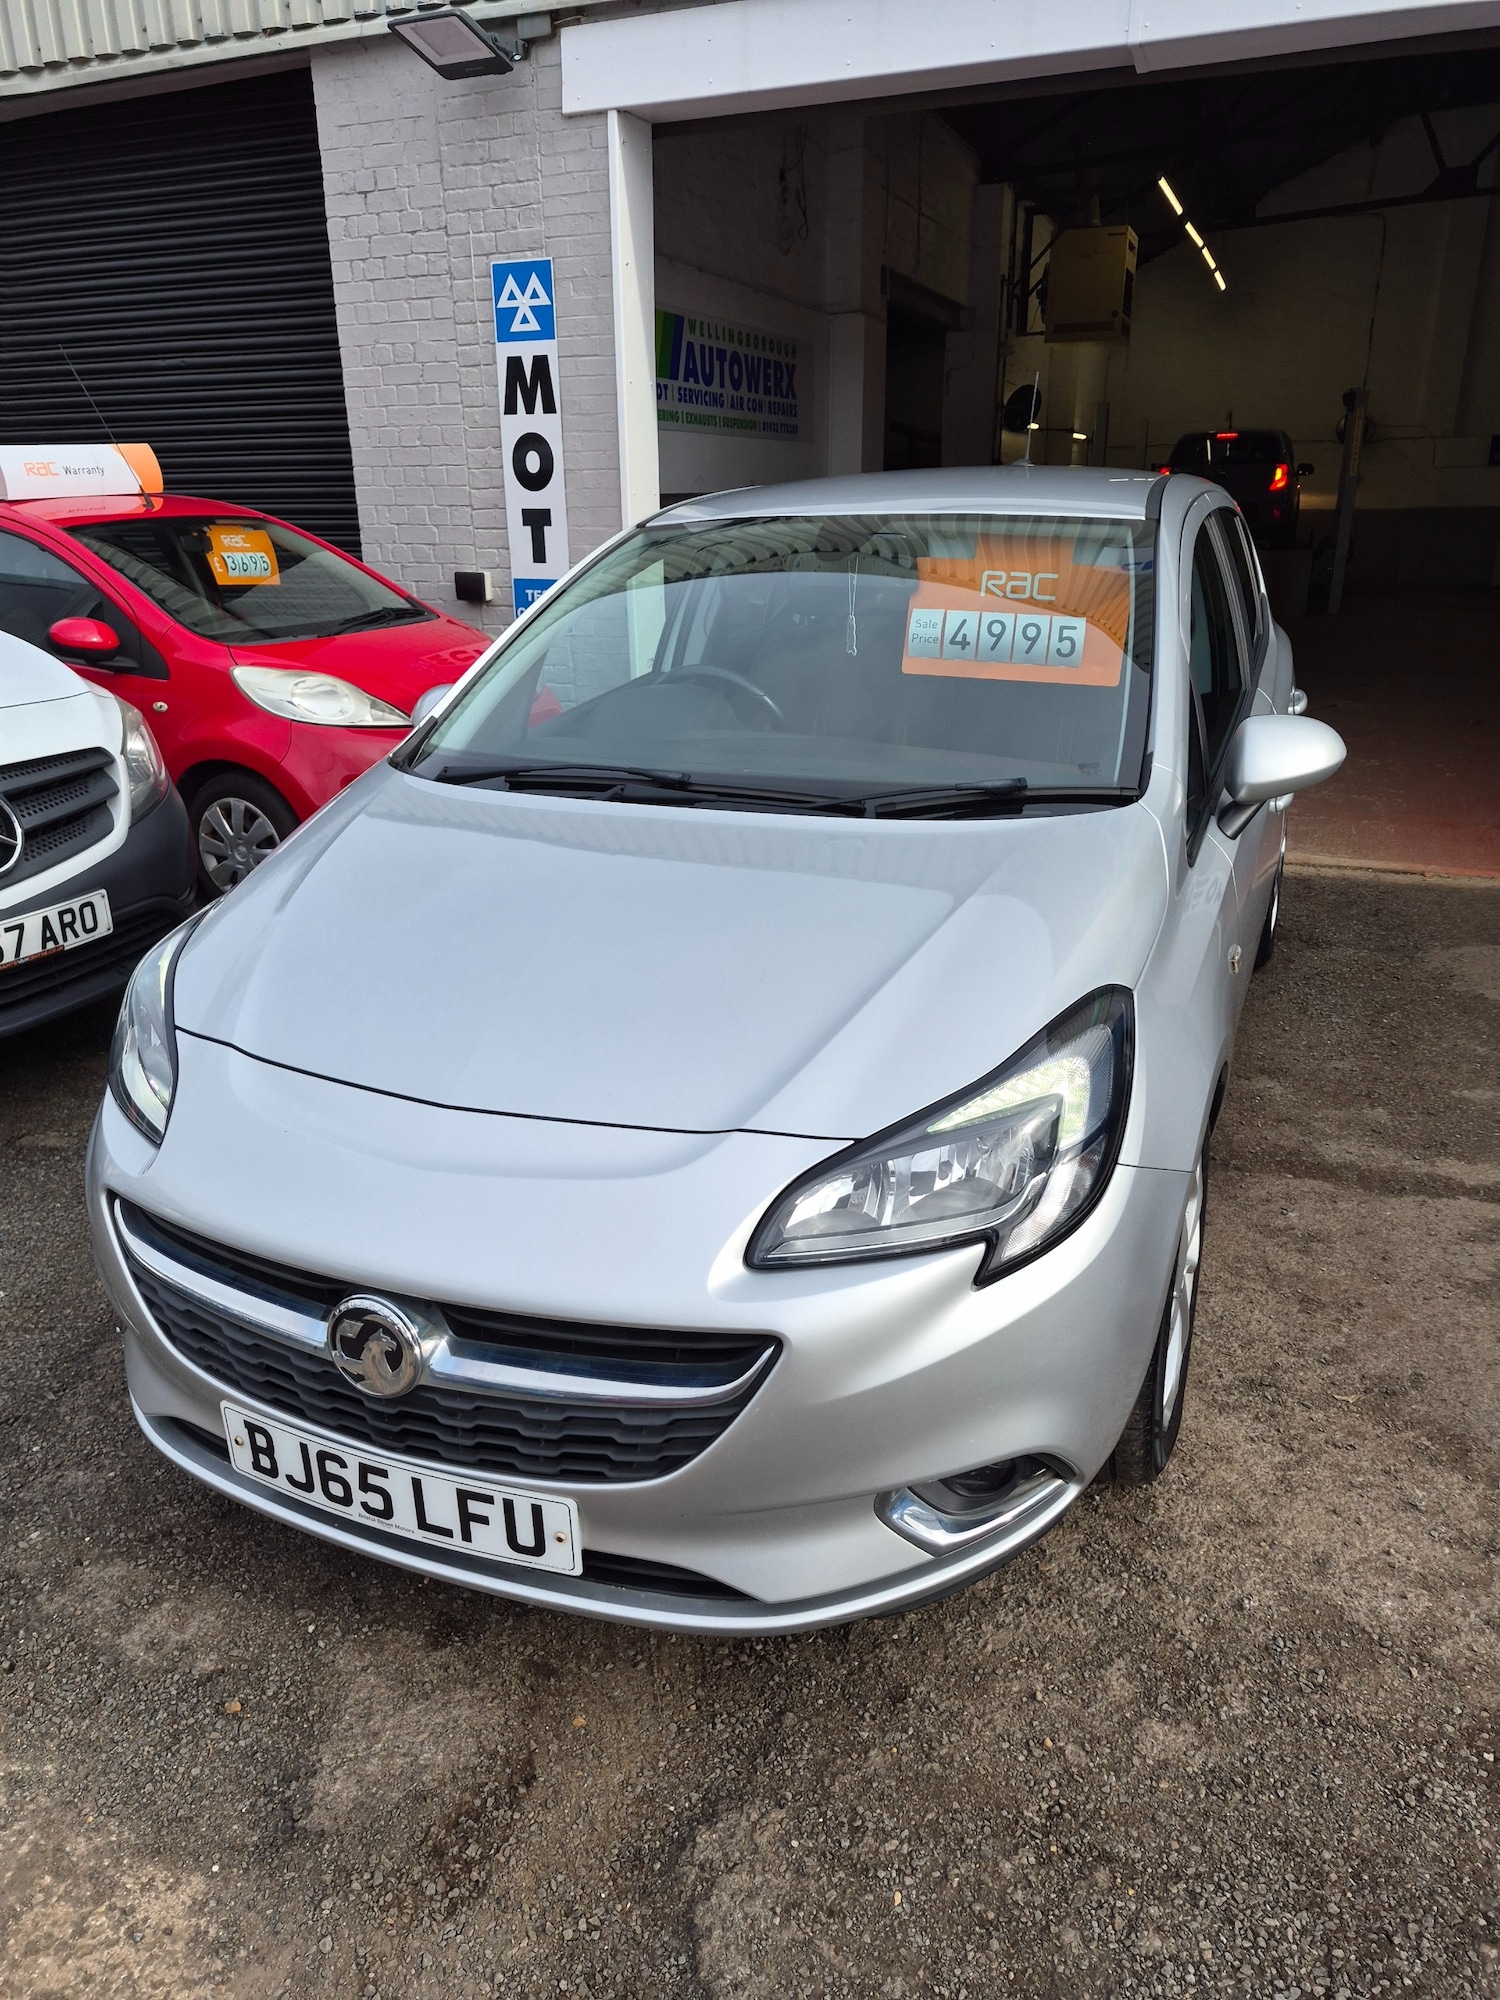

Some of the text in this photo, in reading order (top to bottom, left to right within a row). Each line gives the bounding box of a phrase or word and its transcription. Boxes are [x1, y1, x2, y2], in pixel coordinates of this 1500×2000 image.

[687, 317, 797, 359] WELLINGBOROUGH
[683, 340, 797, 400] AUTOWERX
[678, 386, 725, 409] SERVICING
[730, 394, 745, 411] AIR
[747, 397, 764, 414] CON
[768, 401, 798, 418] REPAIRS
[686, 412, 718, 427] EXHAUSTS
[722, 416, 758, 431] SUSPENSION
[63, 466, 105, 477] Warranty
[504, 354, 557, 564] MOT
[911, 633, 939, 644] Price
[915, 619, 939, 629] Sale
[949, 618, 1078, 658] 4995
[0, 901, 98, 963] 7 ARO
[243, 1419, 547, 1558] BJ65 LFU
